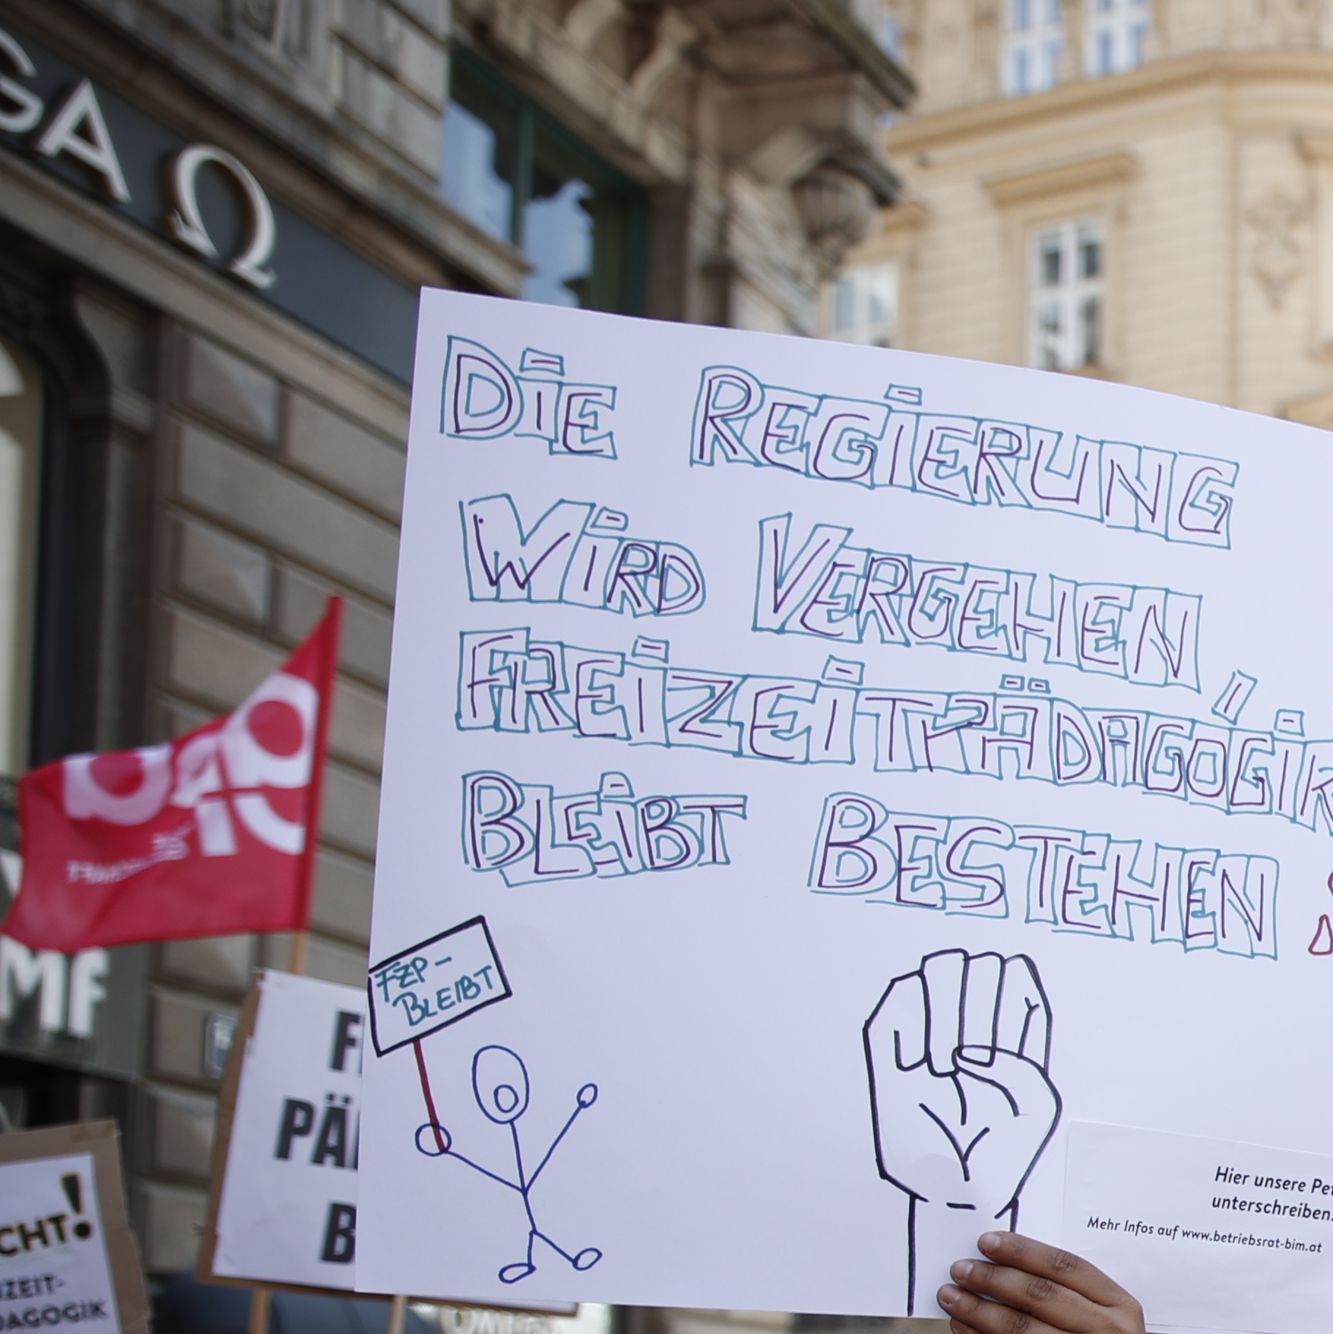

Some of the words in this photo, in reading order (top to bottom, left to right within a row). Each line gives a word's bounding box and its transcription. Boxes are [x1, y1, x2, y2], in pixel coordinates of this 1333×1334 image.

[808, 792, 1279, 960] BESTEHEN
[392, 965, 494, 1026] BLEIBT
[329, 1010, 362, 1077] F
[274, 1093, 359, 1170] PÄ
[1214, 1166, 1249, 1186] Hier
[1254, 1175, 1306, 1192] unsere
[1087, 1216, 1121, 1232] Mehr
[1124, 1219, 1154, 1236] Infos
[1157, 1225, 1180, 1241] auf
[1182, 1229, 1322, 1254] www.betriebsrat-bim.at
[0, 1300, 108, 1333] AGOGIK
